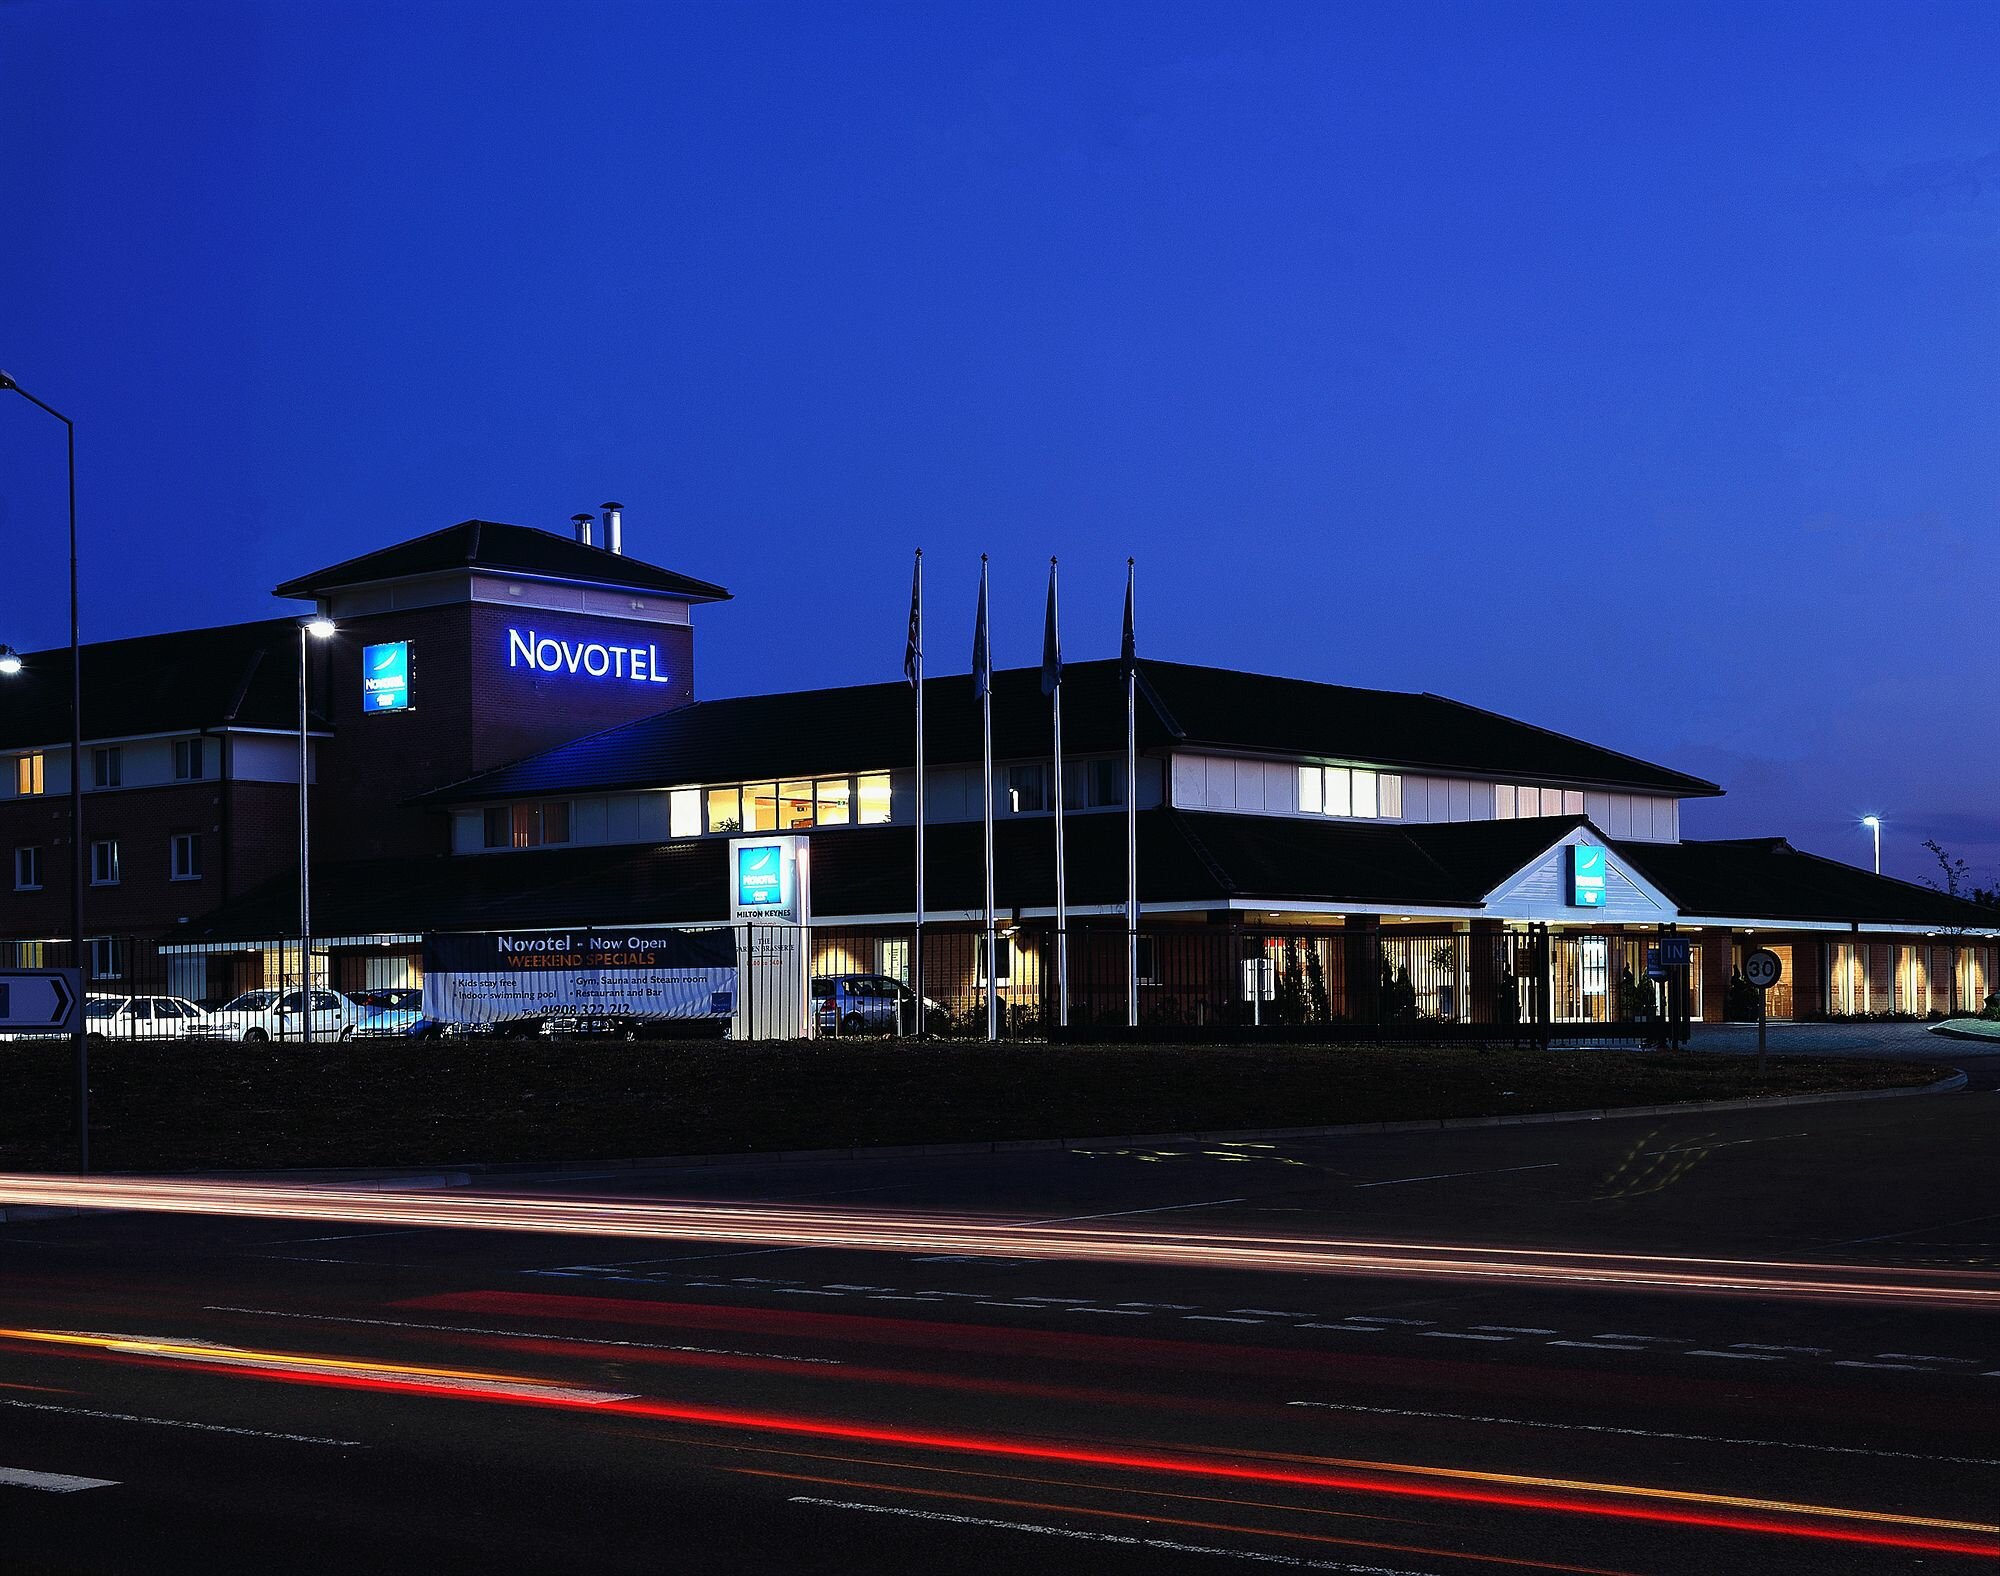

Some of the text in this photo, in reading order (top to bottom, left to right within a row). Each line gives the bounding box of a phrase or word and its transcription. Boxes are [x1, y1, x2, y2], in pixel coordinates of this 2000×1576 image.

[508, 629, 668, 682] NOVOTEL
[765, 909, 791, 917] KEYNES
[498, 935, 570, 952] Novotel
[590, 937, 622, 949] Now
[628, 937, 666, 952] Open
[1667, 944, 1683, 959] IN
[508, 953, 656, 968] WEEKEND SPECIALS
[1749, 961, 1773, 977] 30
[459, 979, 517, 989] Kids stay free
[576, 977, 599, 986] Gym,
[601, 976, 628, 985] Sauna
[631, 976, 647, 984] and
[650, 976, 680, 984] Steam
[459, 990, 557, 1000] Indoor swimming pool
[576, 989, 662, 998] Restaurant and Bar
